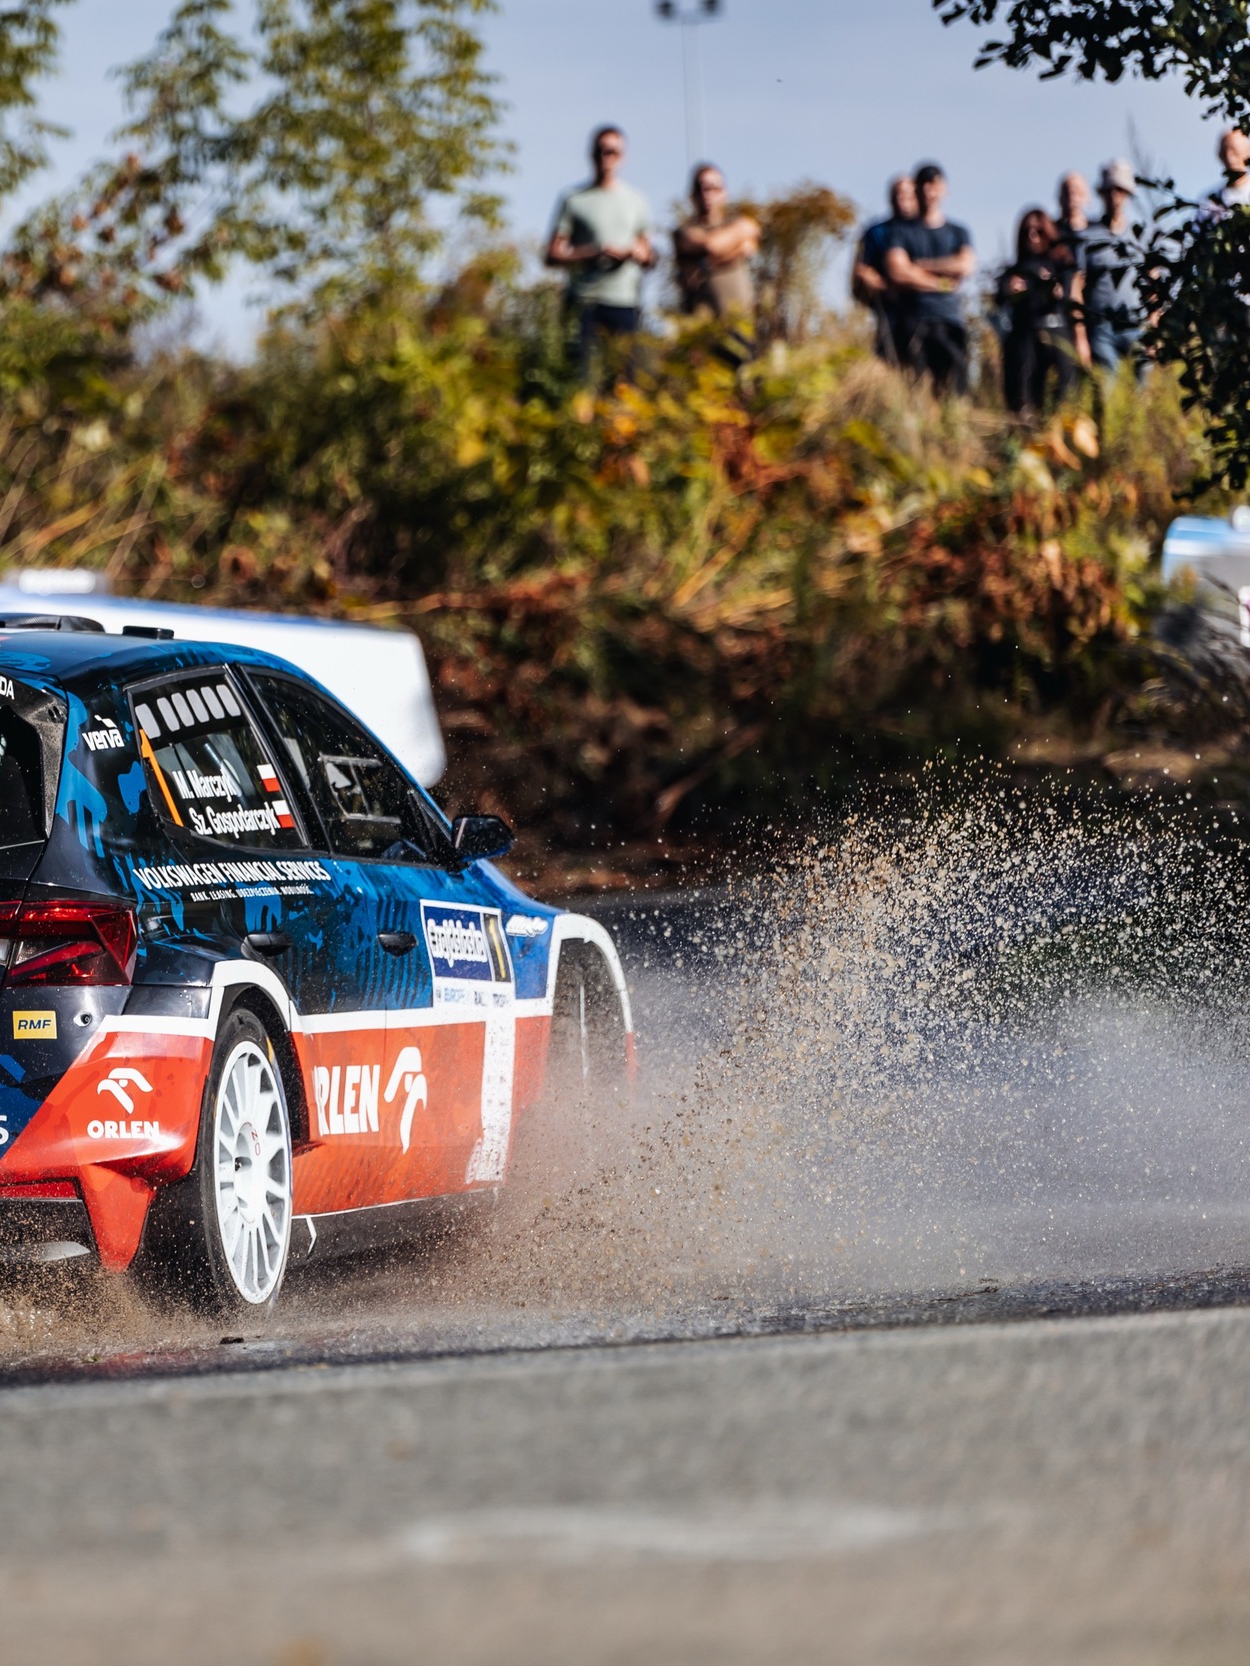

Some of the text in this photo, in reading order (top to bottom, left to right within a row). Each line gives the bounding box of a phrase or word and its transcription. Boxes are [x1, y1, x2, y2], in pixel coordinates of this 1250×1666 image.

[82, 728, 125, 751] verva
[187, 768, 239, 802] Marczyk
[189, 801, 281, 839] Sz. Gospodarczyk
[133, 861, 331, 890] VOLKSWAGEN FINANCIAL SERVICES
[488, 918, 506, 978] 1
[18, 1019, 51, 1031] RMF
[312, 1064, 381, 1137] RLEN
[87, 1119, 160, 1139] ORLEN
